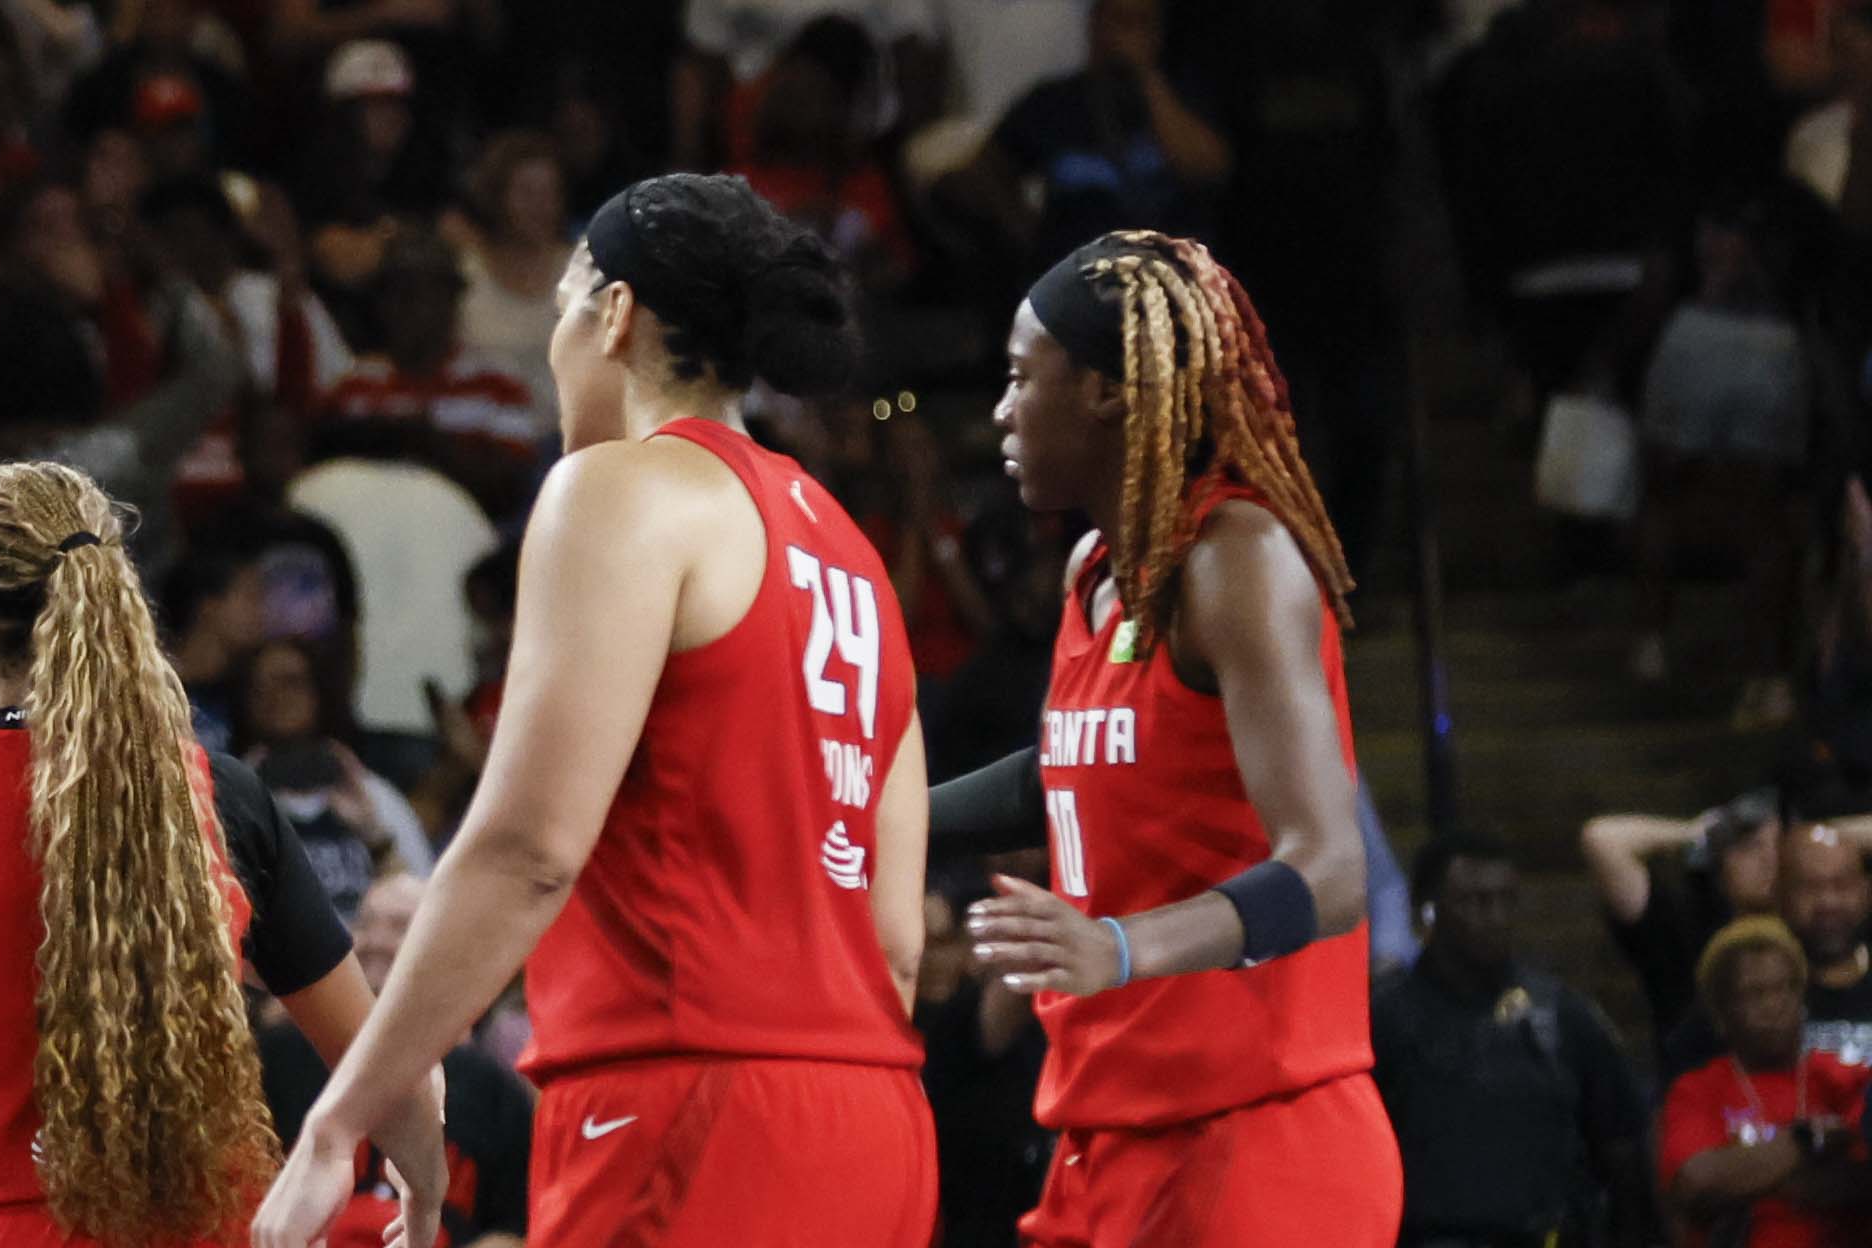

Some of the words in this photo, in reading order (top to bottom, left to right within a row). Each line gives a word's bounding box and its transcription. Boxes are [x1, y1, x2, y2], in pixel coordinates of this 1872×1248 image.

[786, 544, 879, 740] 24
[1040, 707, 1136, 767] ANTA
[1046, 788, 1088, 897] 10
